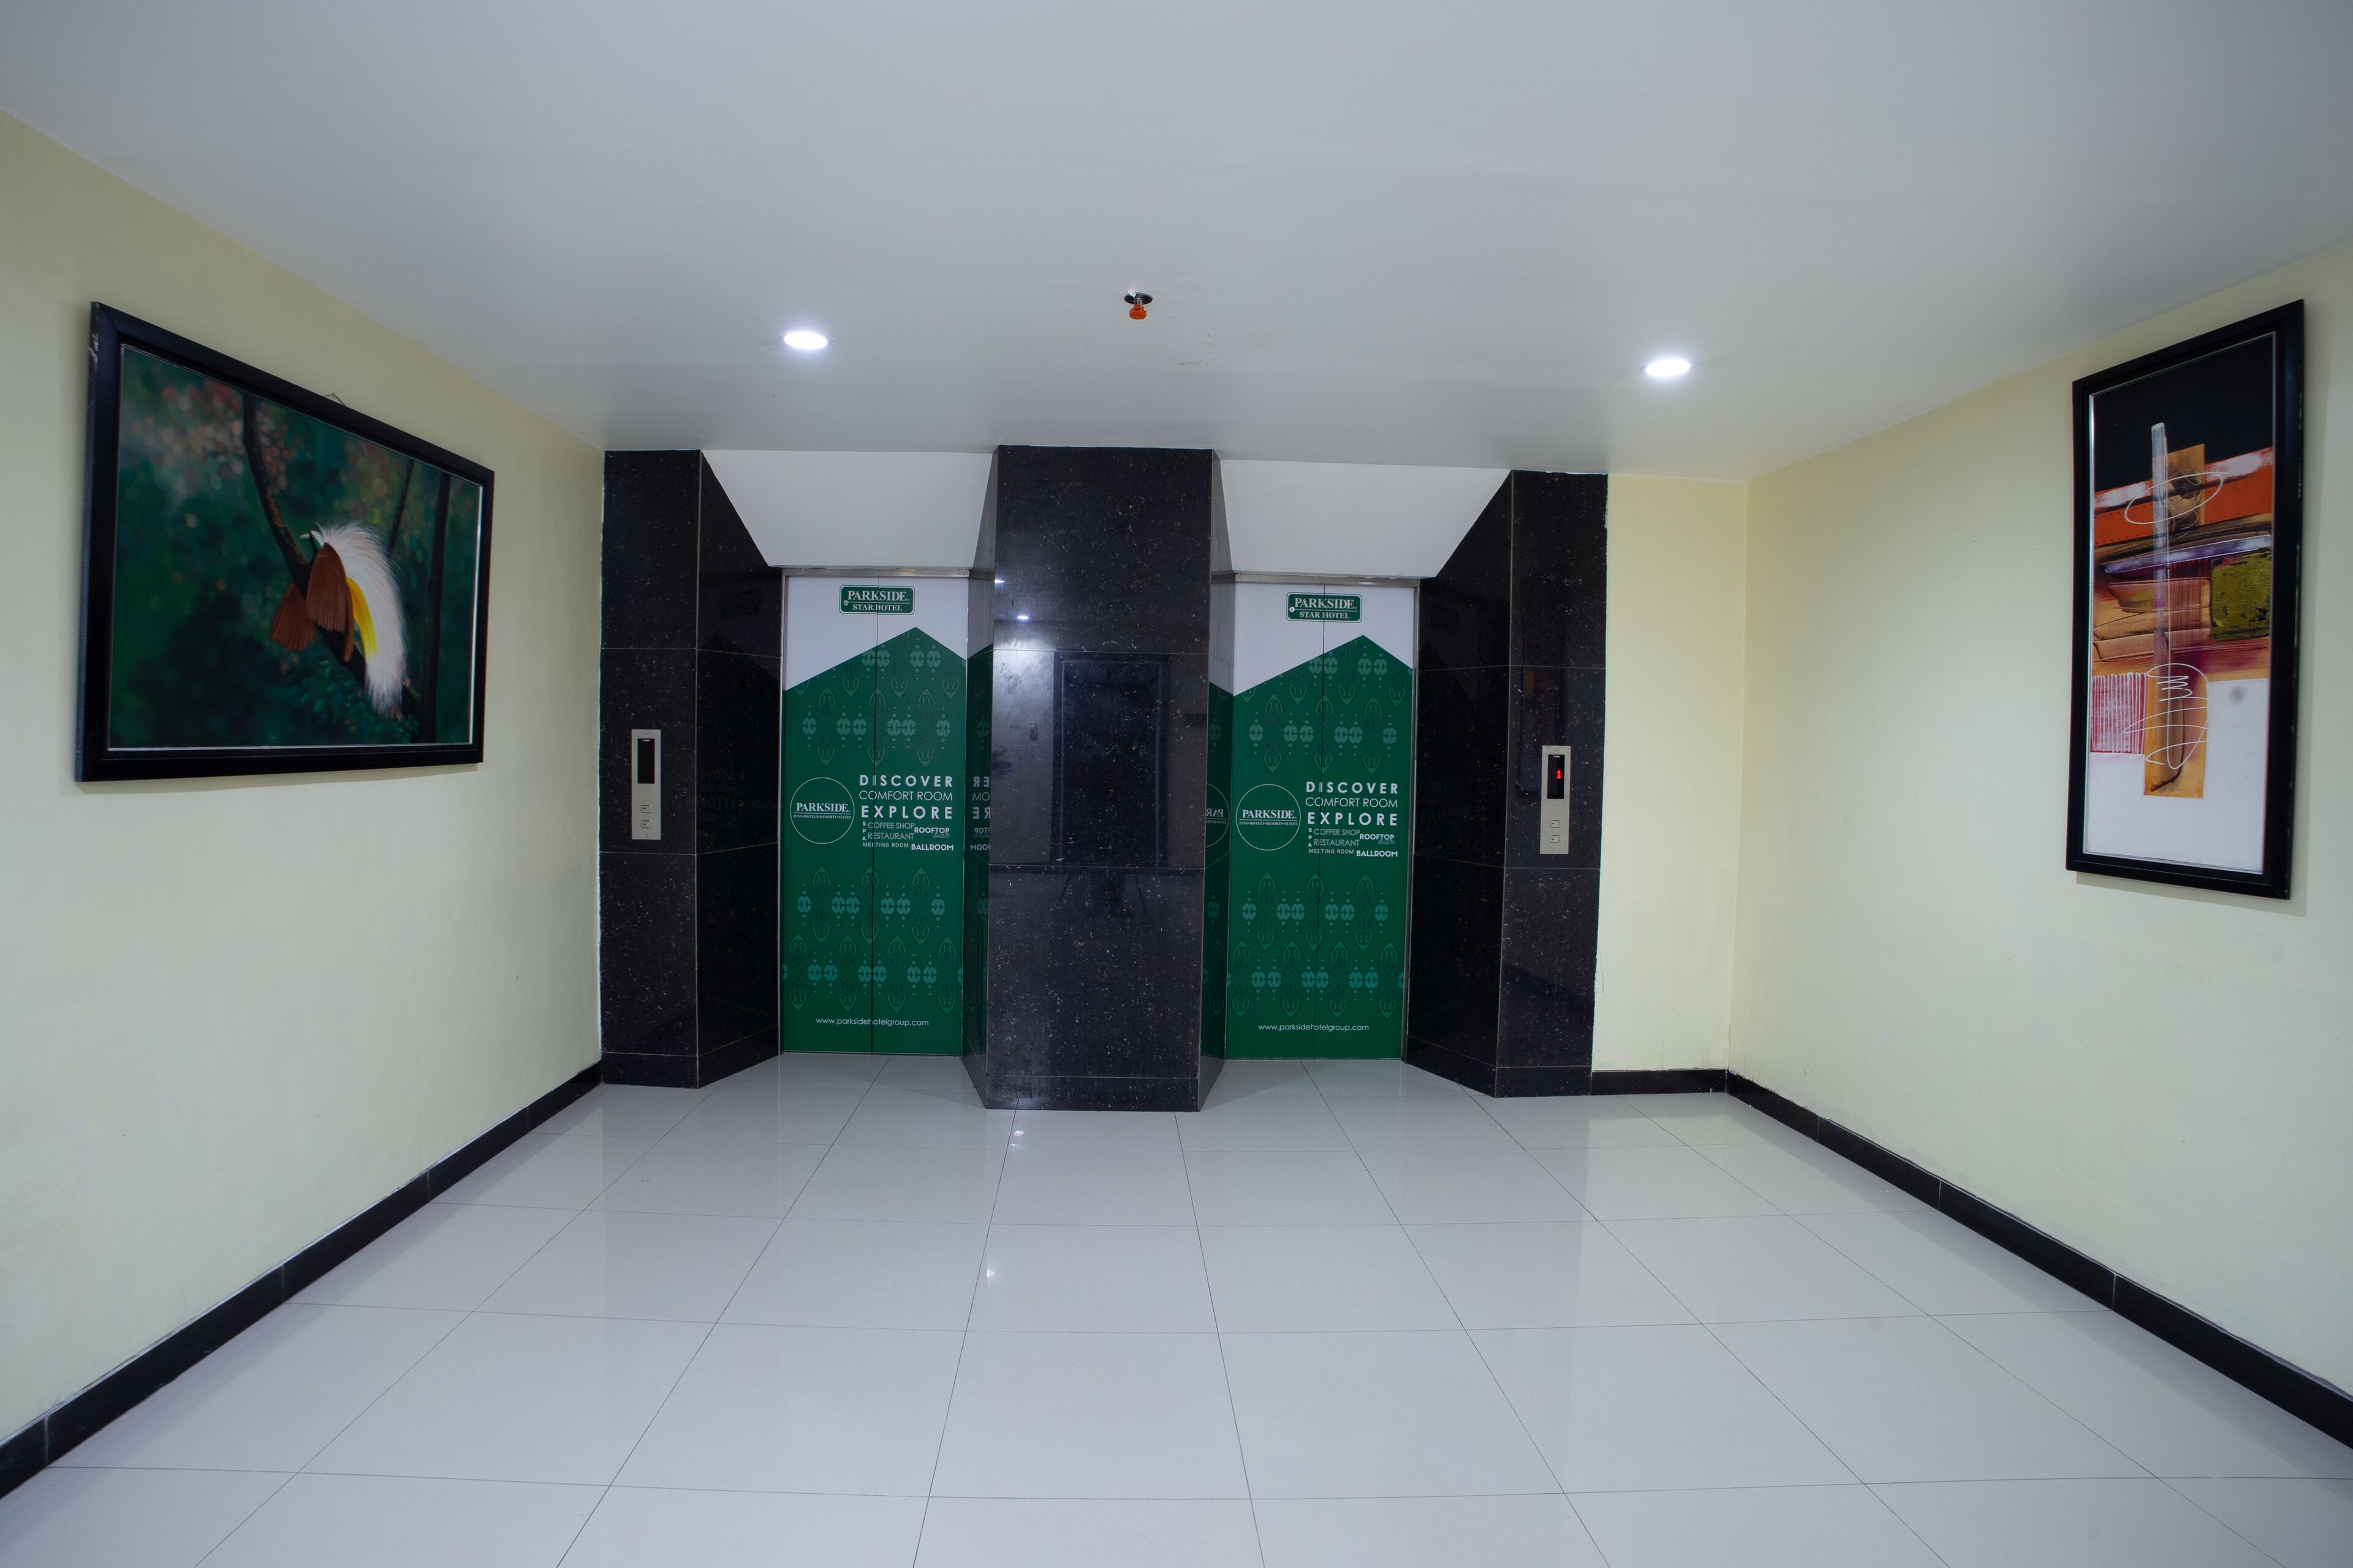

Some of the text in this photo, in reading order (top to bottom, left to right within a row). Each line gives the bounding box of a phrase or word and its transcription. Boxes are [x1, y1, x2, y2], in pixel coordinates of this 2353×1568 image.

[847, 590, 907, 601] PARKSIDE
[1295, 597, 1354, 609] PARKSIDE
[859, 775, 952, 787] DISCOVER
[1306, 781, 1398, 794] DISCOVER
[859, 790, 952, 801] COMFORT ROOM
[797, 802, 849, 812] PARKSIDE
[1305, 797, 1398, 808] COMFORT ROOM
[862, 805, 952, 819] EXPLORE
[1242, 809, 1295, 819] PARKSIDE
[1308, 812, 1397, 826] EXPLORE
[816, 1018, 929, 1027] www.parksidehotelgroup.com
[1258, 1024, 1369, 1032] www.parksidehotelgroup.com
